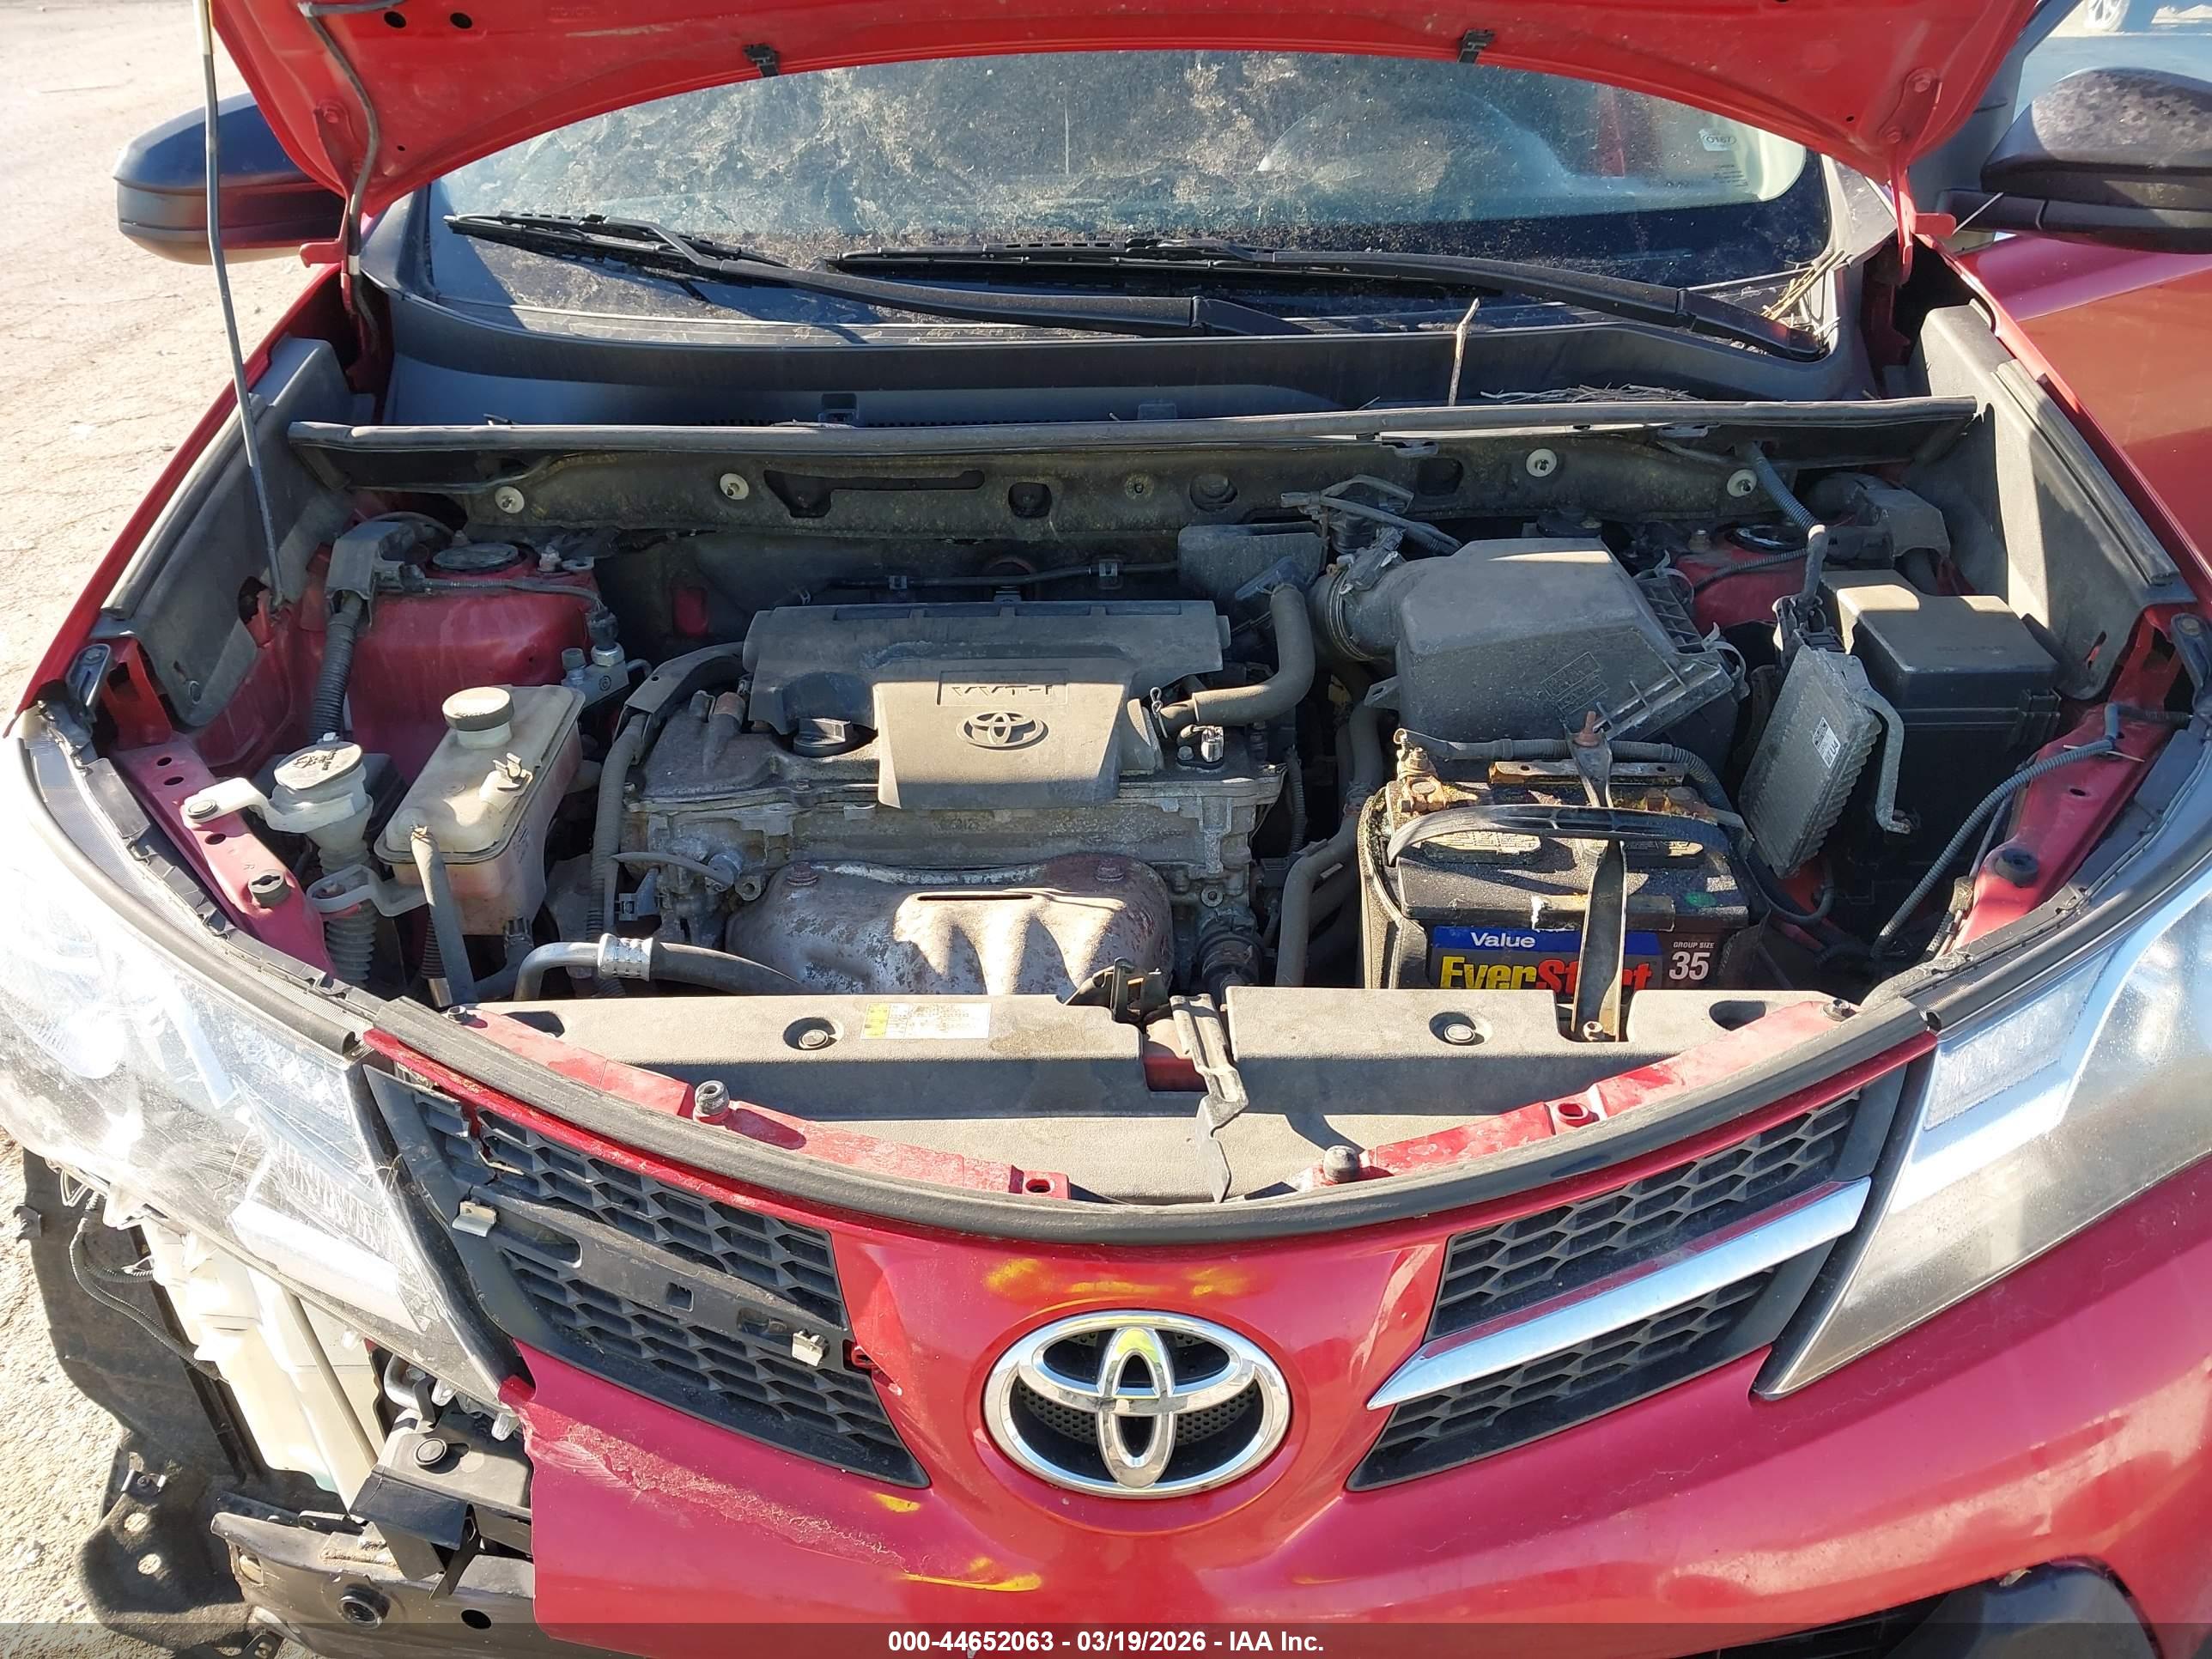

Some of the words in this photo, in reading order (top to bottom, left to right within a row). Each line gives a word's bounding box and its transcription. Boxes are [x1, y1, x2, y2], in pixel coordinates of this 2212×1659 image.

[1469, 932, 1536, 949] Value
[1441, 956, 1653, 994] EverStt
[1668, 951, 1711, 981] 35
